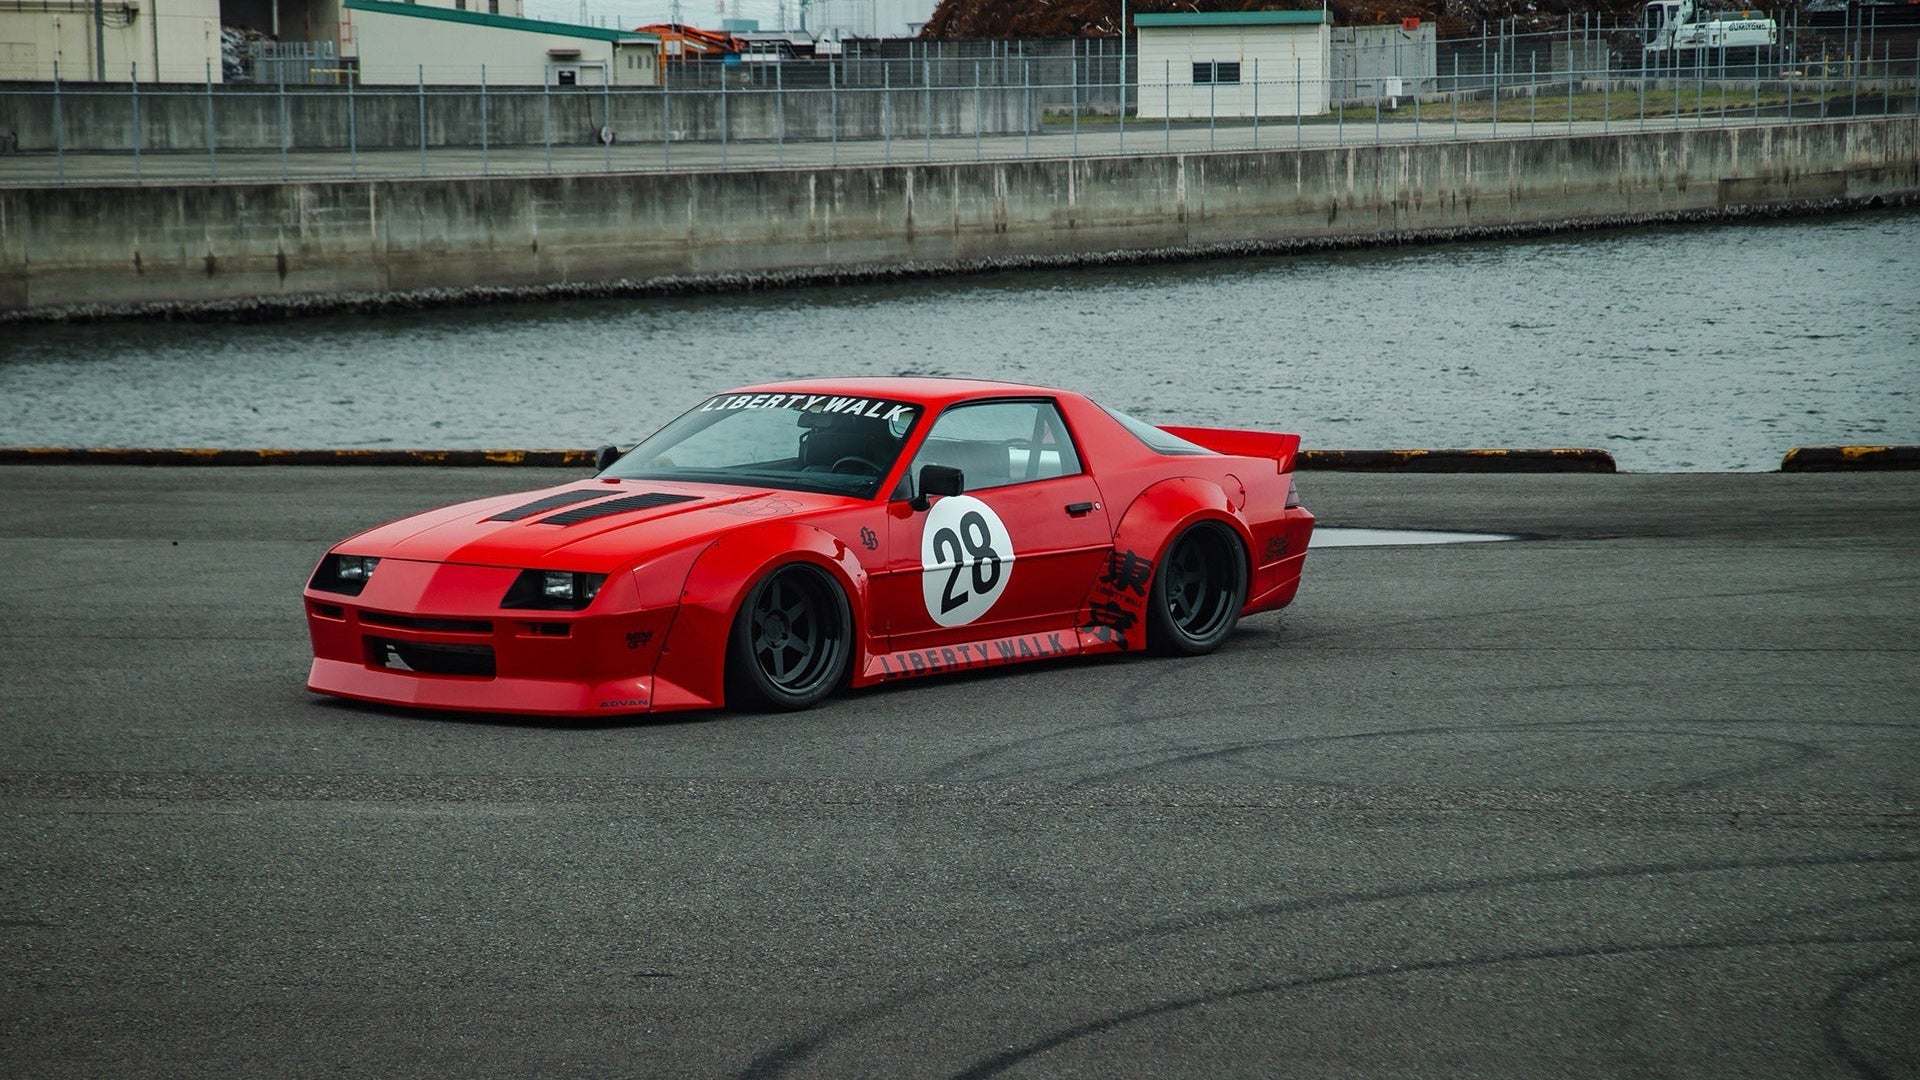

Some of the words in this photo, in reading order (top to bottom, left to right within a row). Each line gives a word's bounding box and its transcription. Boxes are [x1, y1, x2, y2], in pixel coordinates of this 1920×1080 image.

[701, 395, 826, 412] LIBERTY
[822, 398, 914, 422] WALK
[932, 511, 1001, 615] 28
[879, 643, 990, 678] LIBERTY
[994, 633, 1067, 663] WALK
[600, 699, 649, 707] ADVAN
